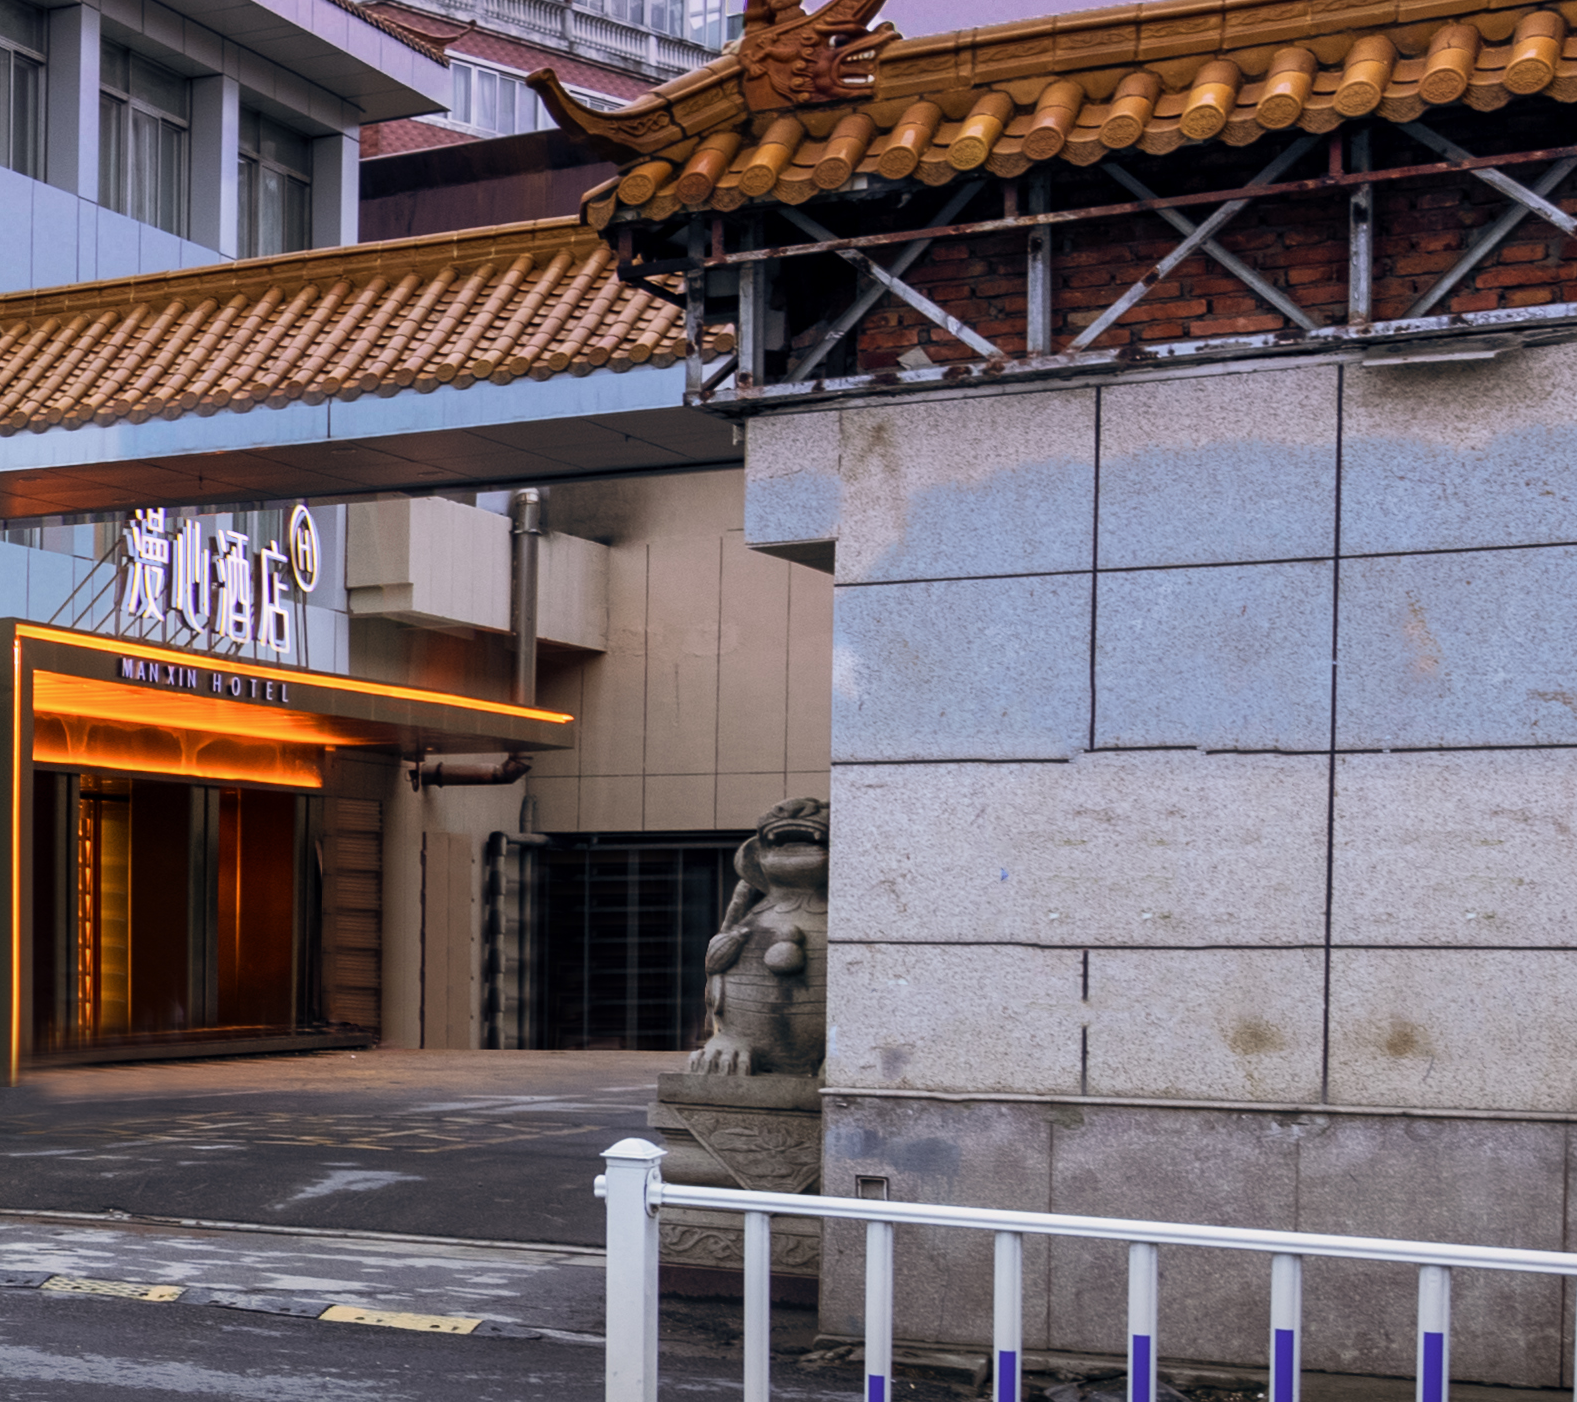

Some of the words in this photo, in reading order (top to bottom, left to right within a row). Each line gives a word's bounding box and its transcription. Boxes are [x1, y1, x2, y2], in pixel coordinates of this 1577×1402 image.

[122, 507, 291, 654] 漫心酒店
[122, 658, 159, 683] MAN
[167, 665, 197, 688] XIN
[212, 672, 289, 703] HOTEL
